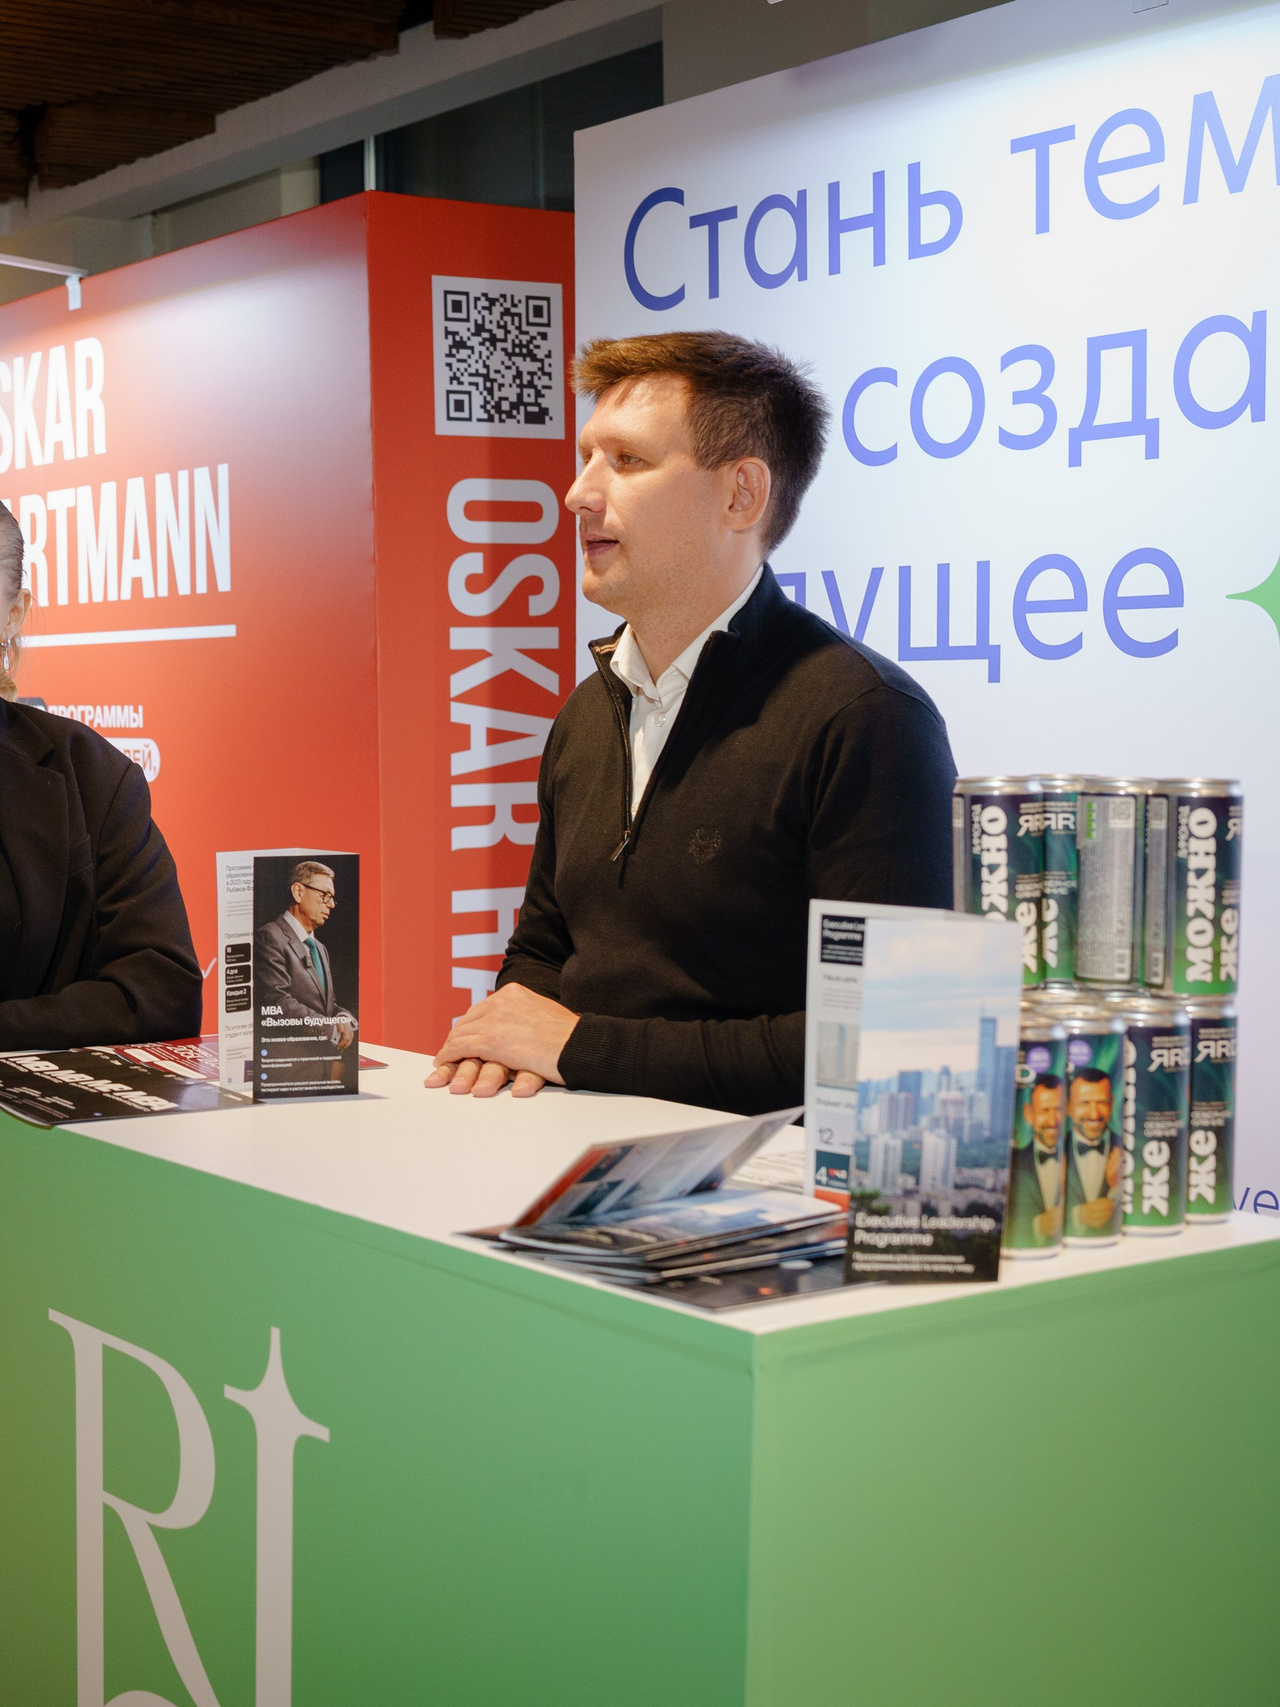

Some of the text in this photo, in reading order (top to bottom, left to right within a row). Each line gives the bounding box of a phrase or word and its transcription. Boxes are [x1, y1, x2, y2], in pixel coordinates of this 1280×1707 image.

[623, 162, 963, 311] Стань
[842, 310, 1267, 467] созда
[4, 464, 231, 608] RTMANN
[446, 478, 560, 851] OSKAR
[261, 1016, 352, 1027] «Вызовы будущего»
[853, 1228, 935, 1249] Programme
[855, 1211, 996, 1233] Executive Leadership
